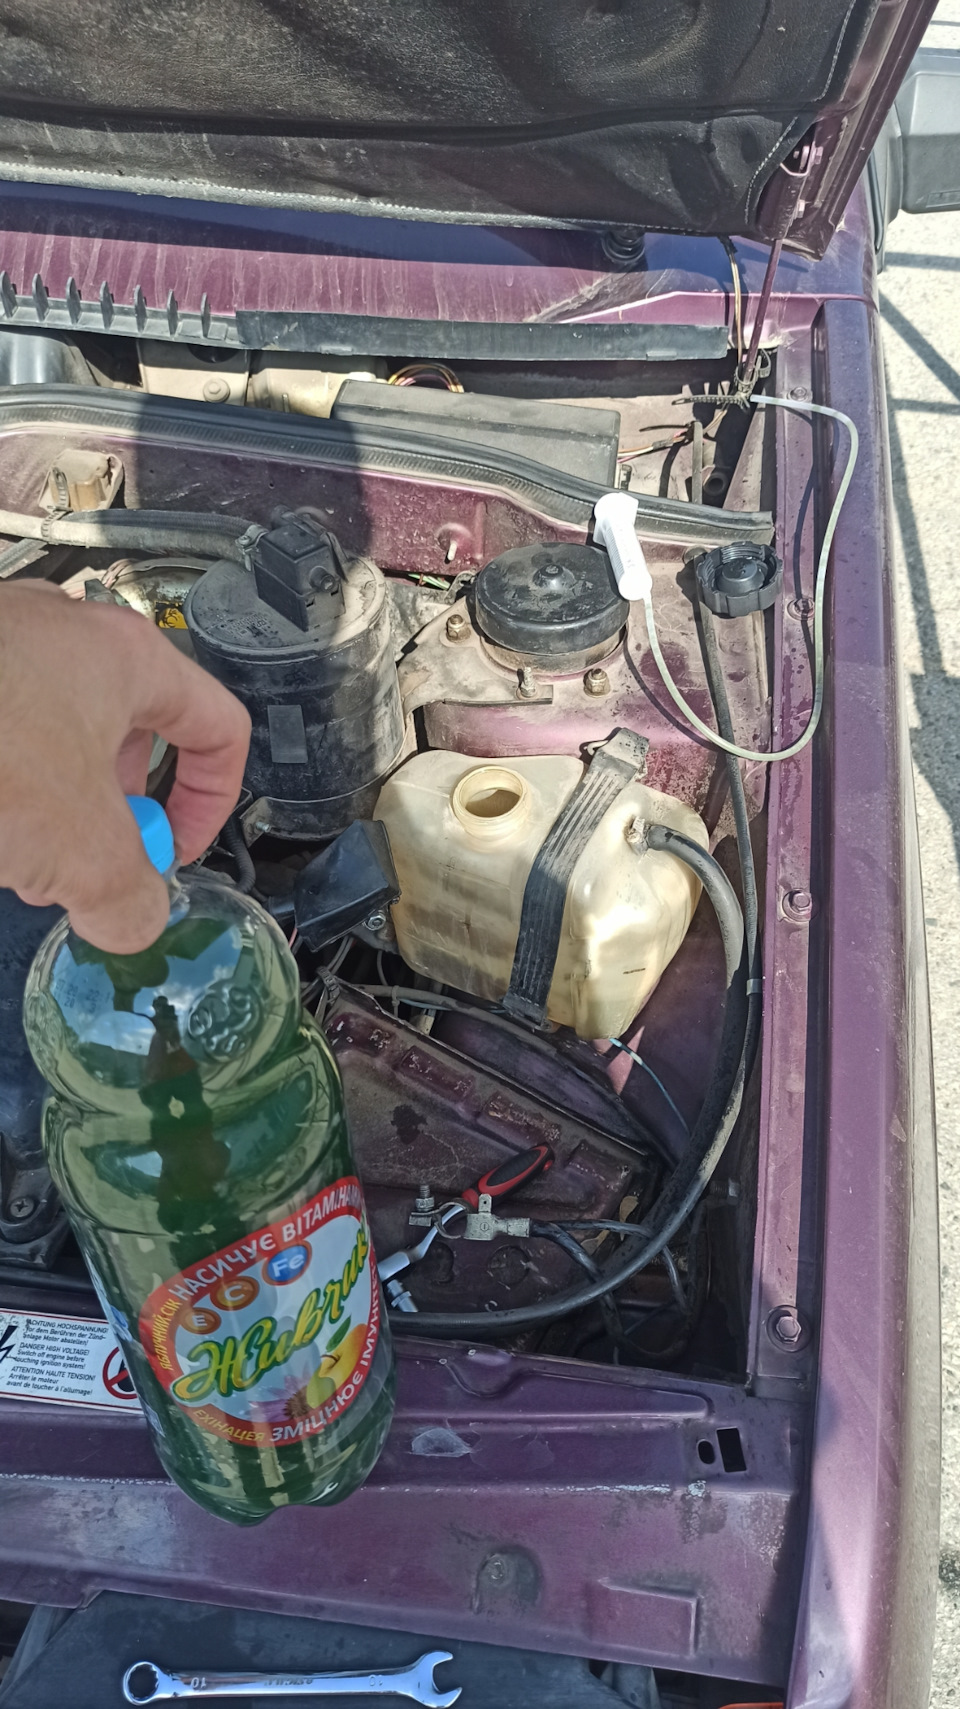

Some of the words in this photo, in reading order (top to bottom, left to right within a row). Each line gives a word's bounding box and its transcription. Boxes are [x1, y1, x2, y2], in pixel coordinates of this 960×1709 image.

[168, 1233, 276, 1301] НАСИЧУЄ
[272, 1254, 305, 1278] Fe
[224, 1284, 245, 1303] C
[160, 1298, 183, 1317] СІК
[27, 1319, 56, 1329] ACHTUNG
[57, 1323, 109, 1334] HOCHSPANNUNG!
[50, 1329, 77, 1337] Berühren
[20, 1342, 45, 1350] DANGER
[62, 1347, 90, 1356] VOLTAGE!
[60, 1338, 89, 1346] abstellen!
[152, 1312, 174, 1371] ЯБЛУЧНИЙ
[40, 1360, 61, 1368] ignition
[62, 1362, 86, 1370] system!
[46, 1353, 65, 1361] engine
[66, 1355, 85, 1363] before
[11, 1366, 44, 1375] ATTENTION
[67, 1372, 96, 1381] TENSION!
[32, 1383, 54, 1391] toucher
[270, 1371, 363, 1442] ЗМІЦНЮЄ
[194, 1409, 266, 1442] ЕХІНАЦЕЯ
